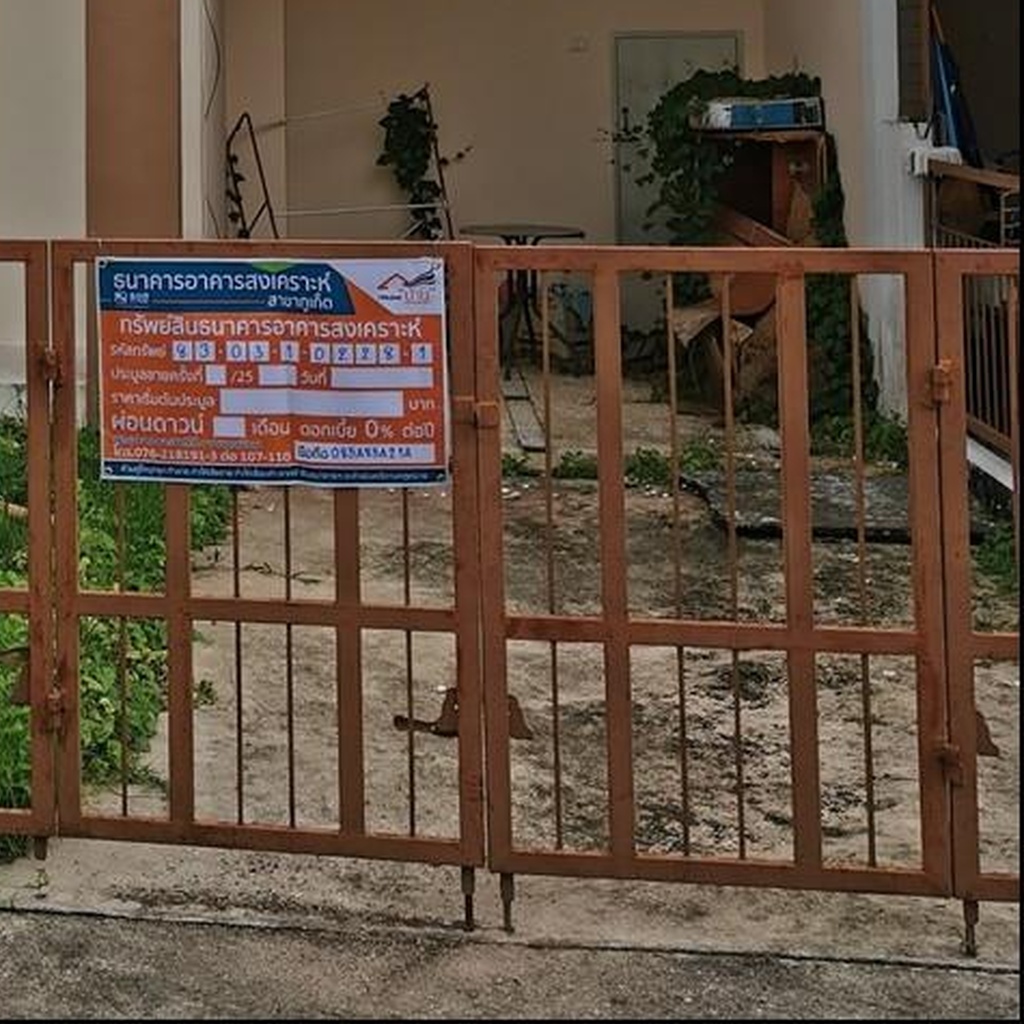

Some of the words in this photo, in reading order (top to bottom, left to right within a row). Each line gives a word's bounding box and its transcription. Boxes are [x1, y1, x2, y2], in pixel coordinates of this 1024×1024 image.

[113, 270, 332, 293] ธนาคารอาคารสงเคราะห์
[267, 292, 333, 314] สาขาภูเก็ต
[119, 315, 423, 338] ทรัพย์สินธนาคารอาคารสงเคราะห์
[111, 411, 204, 434] ผ่อนดาวน์
[251, 417, 291, 436] เดือน
[300, 417, 357, 438] ดอกเบี้ย
